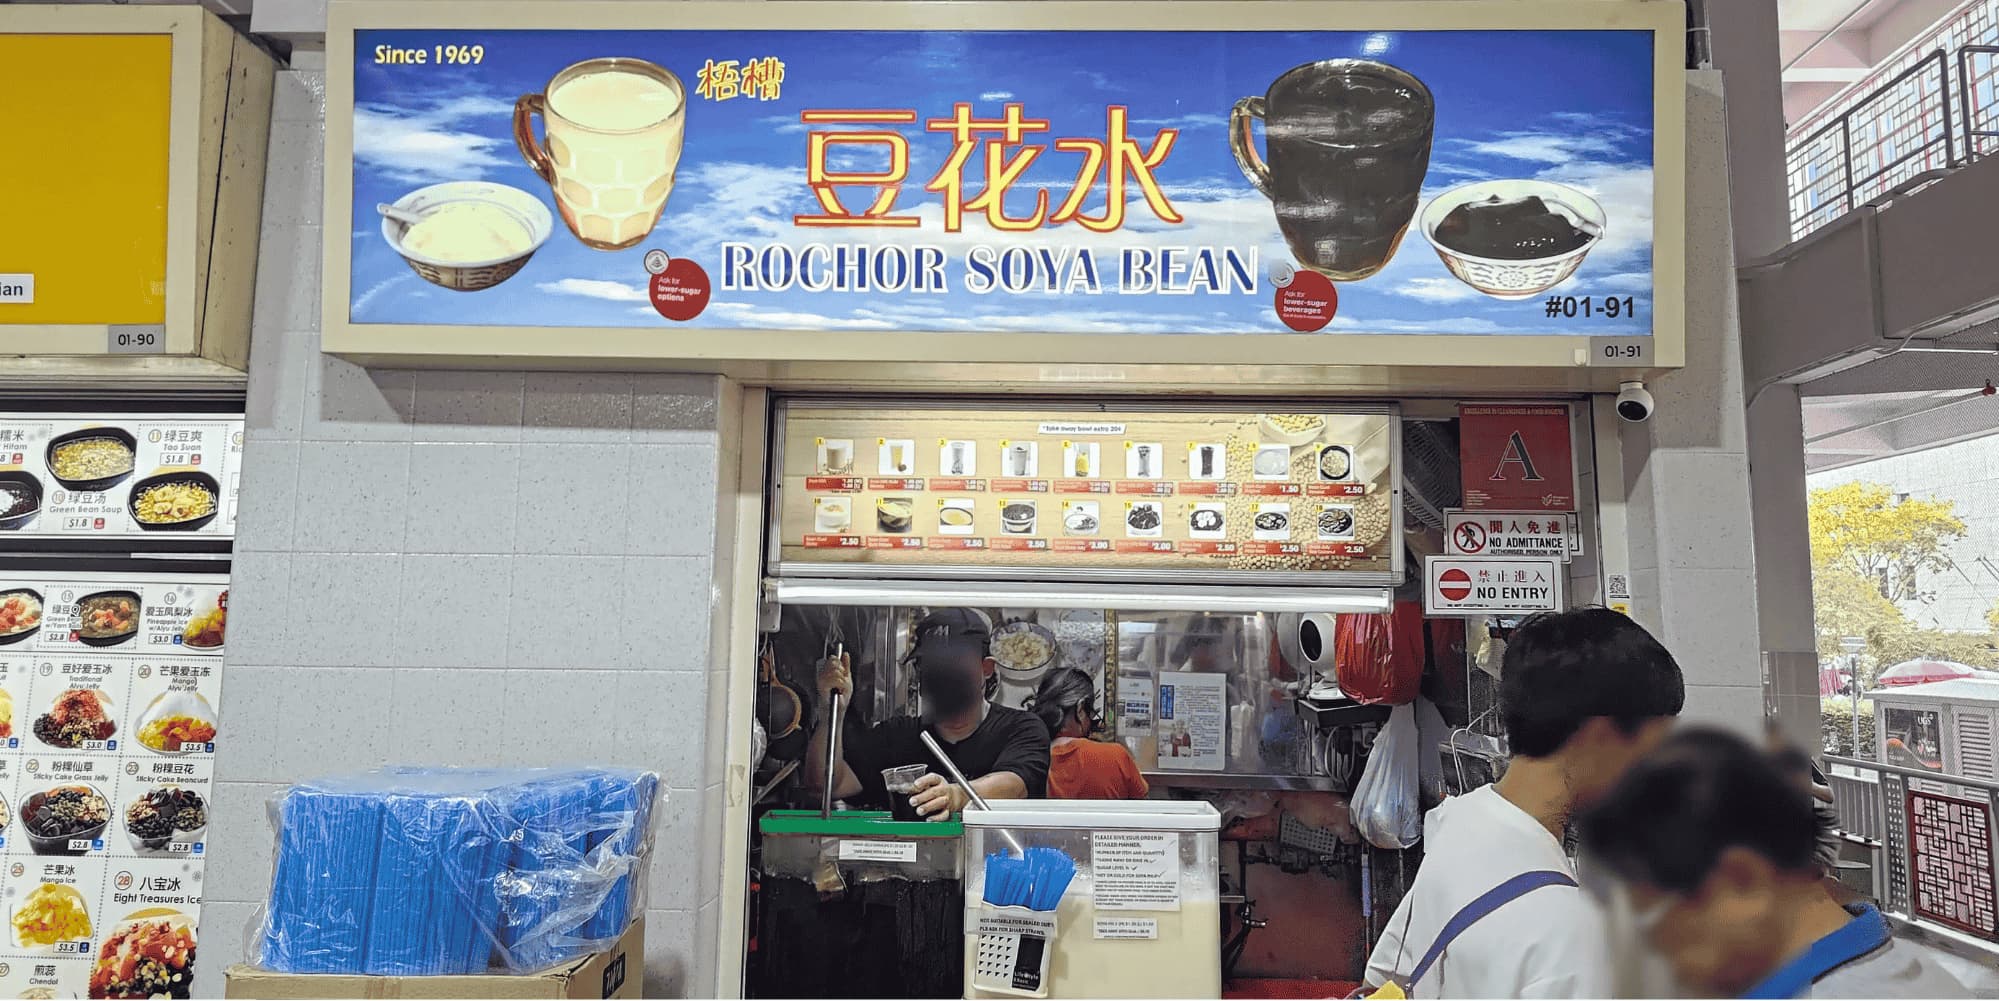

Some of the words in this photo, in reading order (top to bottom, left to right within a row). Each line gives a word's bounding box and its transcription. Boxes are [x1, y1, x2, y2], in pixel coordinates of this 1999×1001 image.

[374, 44, 428, 65] Since
[434, 44, 485, 65] 1969
[696, 58, 786, 101] 梧槽
[794, 102, 1184, 234] 豆花水
[720, 241, 949, 295] ROCHOR
[965, 243, 1103, 296] SOYA
[1119, 245, 1259, 295] BEAN
[657, 285, 701, 296] lower-sugar
[657, 293, 685, 302] options
[1283, 298, 1328, 308] lower-sugar
[1283, 305, 1321, 315] beverages
[1545, 295, 1634, 318] #01-91
[118, 334, 155, 346] 01-90
[1604, 345, 1641, 357] 01-91
[165, 455, 184, 463] $1.8
[1489, 430, 1545, 480] A
[50, 505, 75, 513] Green
[78, 505, 99, 513] Bean
[68, 518, 87, 528] $1.8
[1489, 538, 1501, 548] NO
[1506, 538, 1563, 548] ADMITTANCE
[1477, 587, 1497, 599] NO
[1502, 587, 1549, 599] ENTRY
[86, 741, 102, 749] $3.0
[72, 841, 89, 849] $2.8
[44, 864, 76, 875] 芒果冰
[139, 876, 181, 891] 八宝冰
[114, 893, 137, 904] Eight
[140, 894, 184, 904] Treasures
[58, 944, 75, 952] $3.5
[29, 978, 59, 986] Chendol
